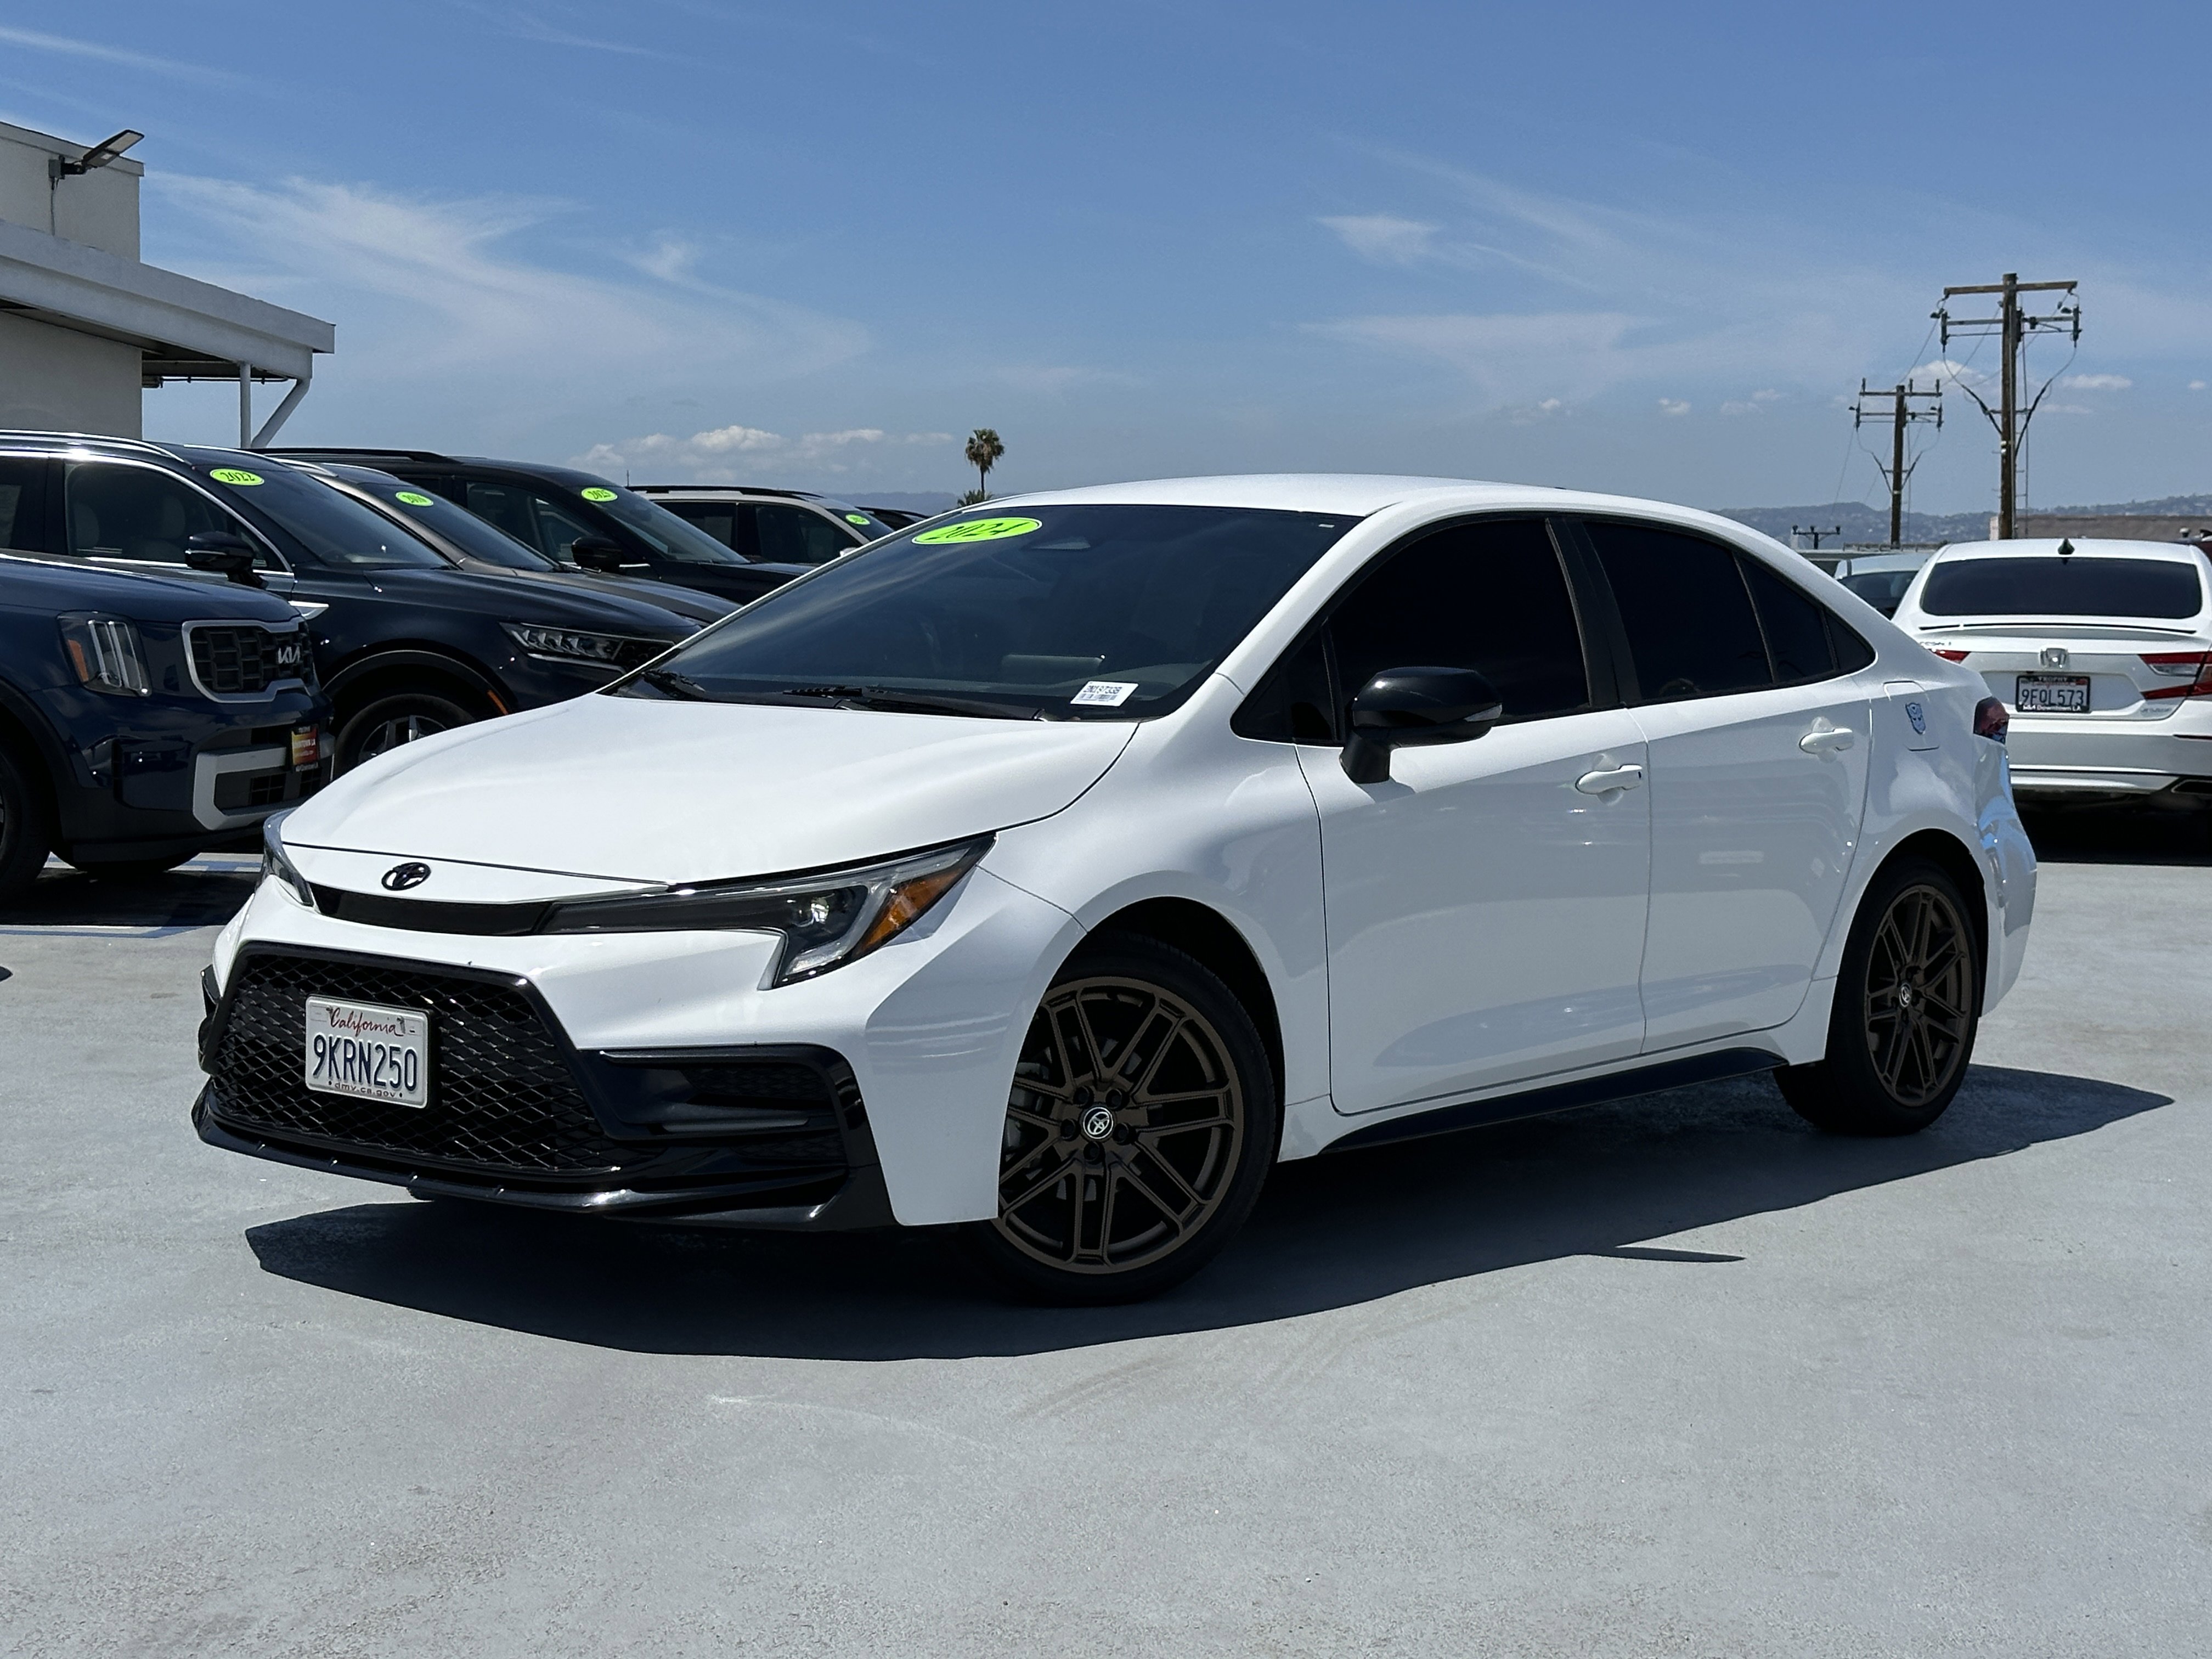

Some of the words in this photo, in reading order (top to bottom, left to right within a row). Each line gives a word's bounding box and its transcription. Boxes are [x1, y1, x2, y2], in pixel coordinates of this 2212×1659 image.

[330, 1007, 404, 1037] California
[313, 1034, 417, 1092] 9KRN250
[334, 1082, 397, 1098] dmv.ca.gov
